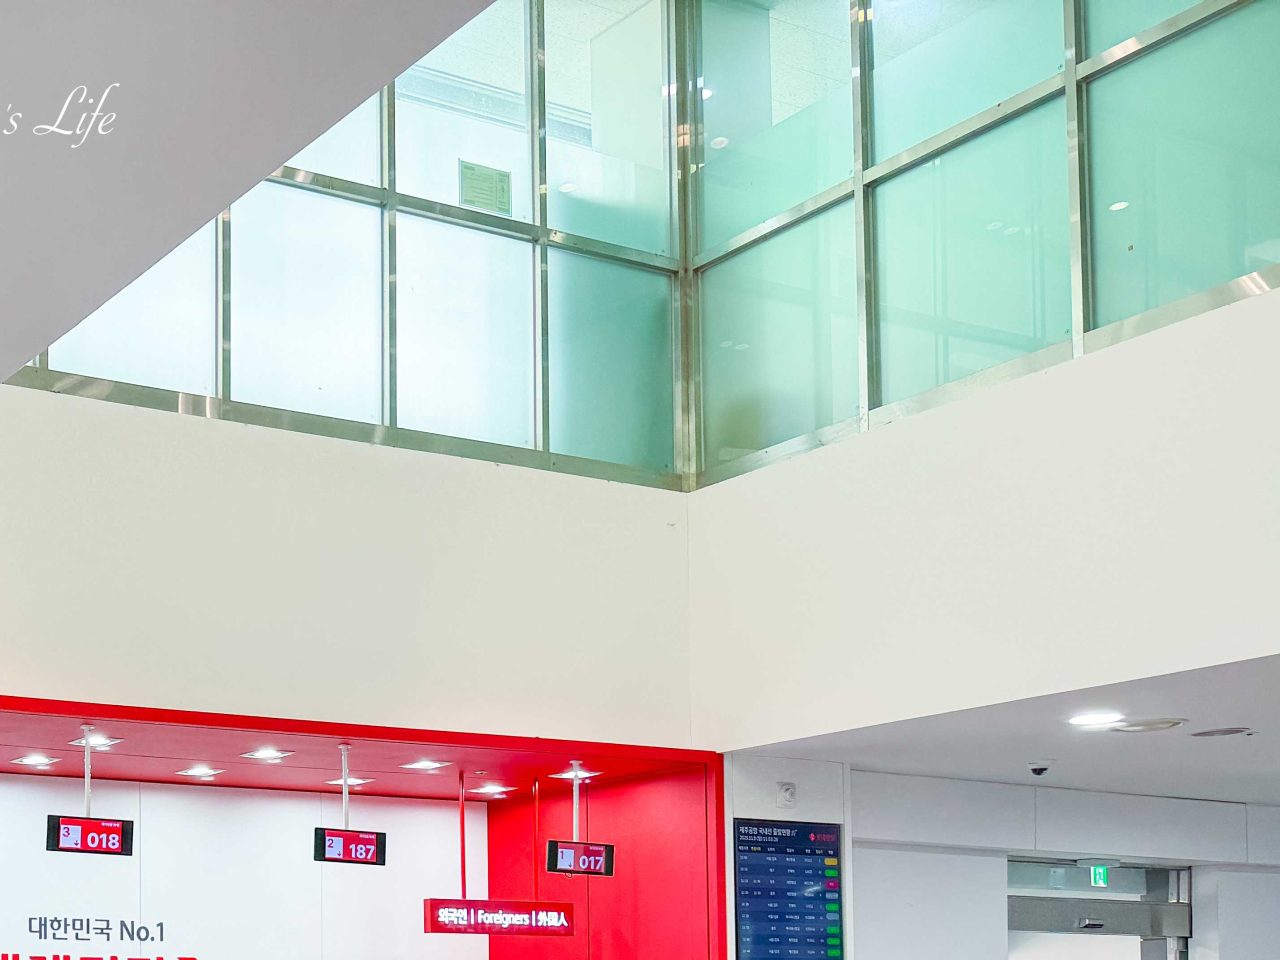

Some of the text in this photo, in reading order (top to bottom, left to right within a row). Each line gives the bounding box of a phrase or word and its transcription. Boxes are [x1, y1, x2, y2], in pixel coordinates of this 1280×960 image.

[63, 827, 70, 837] 3
[87, 832, 119, 849] 018
[327, 839, 334, 848] 2
[349, 844, 375, 860] 187
[559, 850, 564, 860] 1
[579, 855, 604, 870] 017
[438, 908, 467, 925] 외국인
[477, 909, 530, 928] Foreigners
[28, 917, 165, 942] 대한민국 No.1
